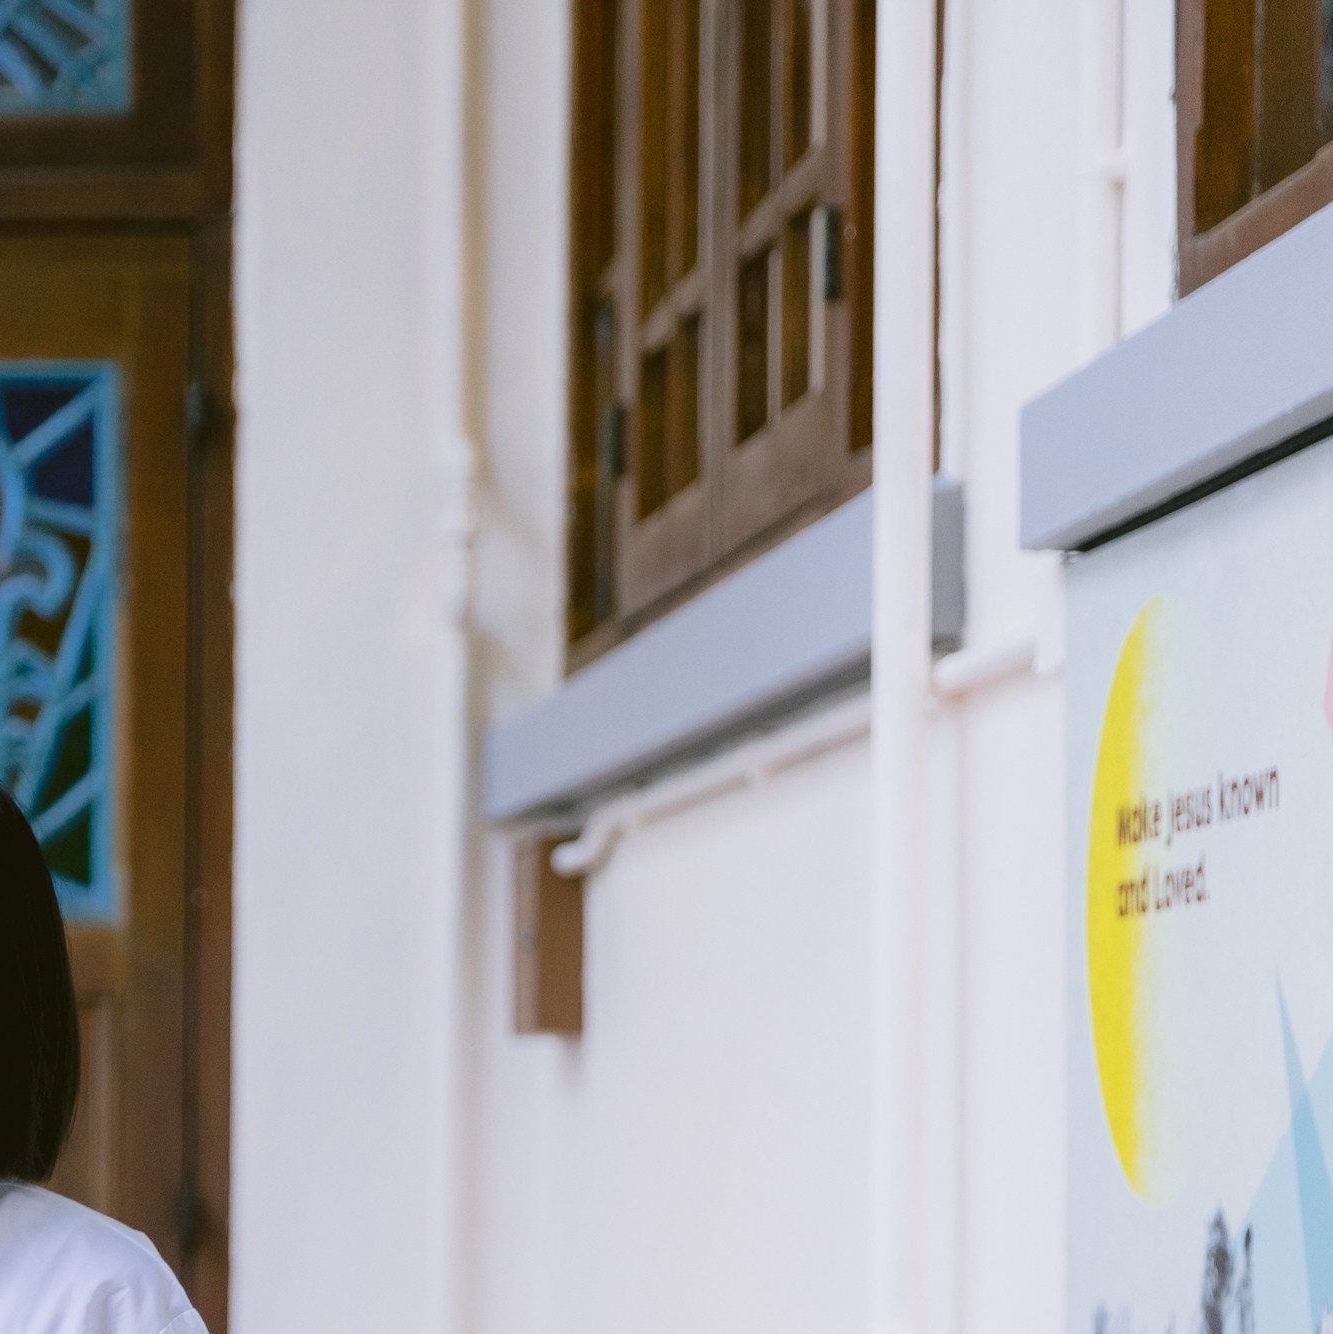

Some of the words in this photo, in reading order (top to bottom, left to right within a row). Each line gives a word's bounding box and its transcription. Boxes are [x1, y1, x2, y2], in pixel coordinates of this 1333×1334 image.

[1117, 795, 1161, 847] Make
[1218, 766, 1279, 821] known
[1117, 862, 1149, 919] and
